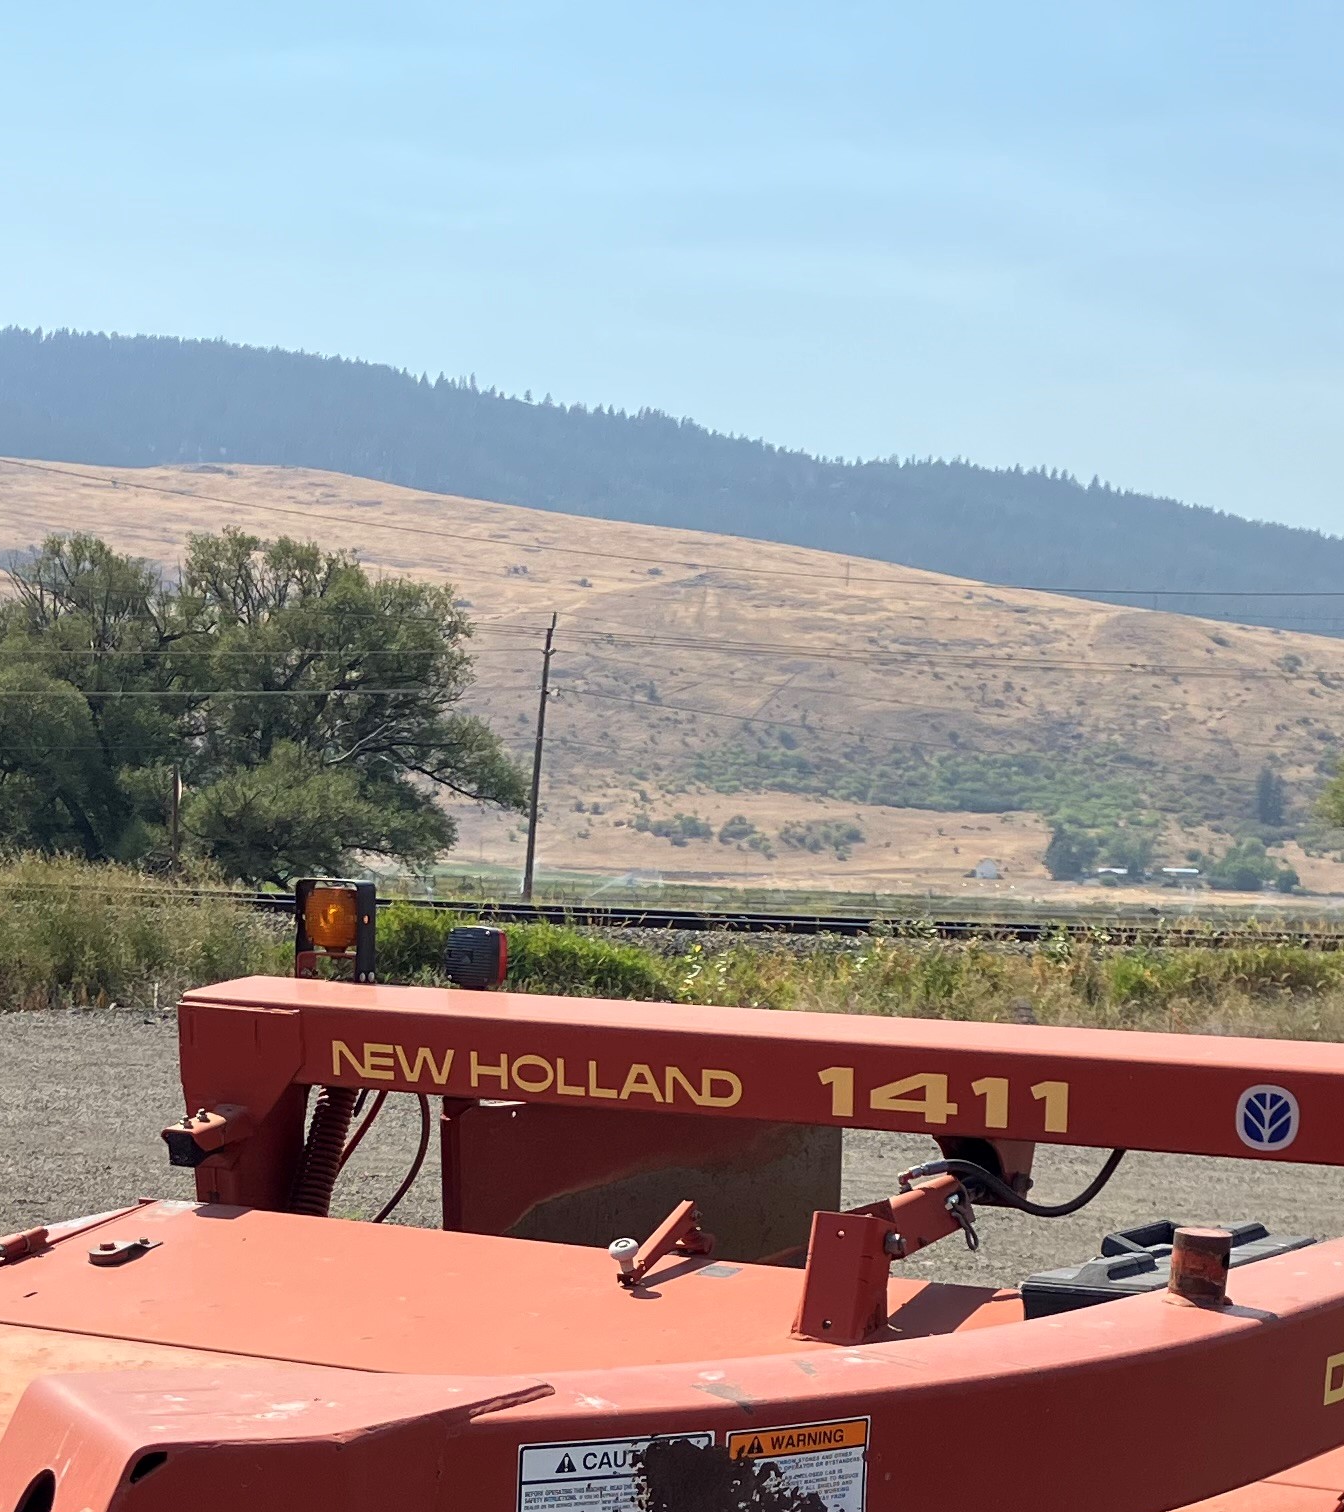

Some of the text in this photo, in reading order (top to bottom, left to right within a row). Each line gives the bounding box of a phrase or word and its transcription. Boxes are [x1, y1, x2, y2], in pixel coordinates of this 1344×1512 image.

[330, 1039, 743, 1108] NEW HOLLAND
[817, 1067, 1070, 1134] 1411
[583, 1450, 641, 1470] CAUT
[771, 1429, 844, 1450] WARNING
